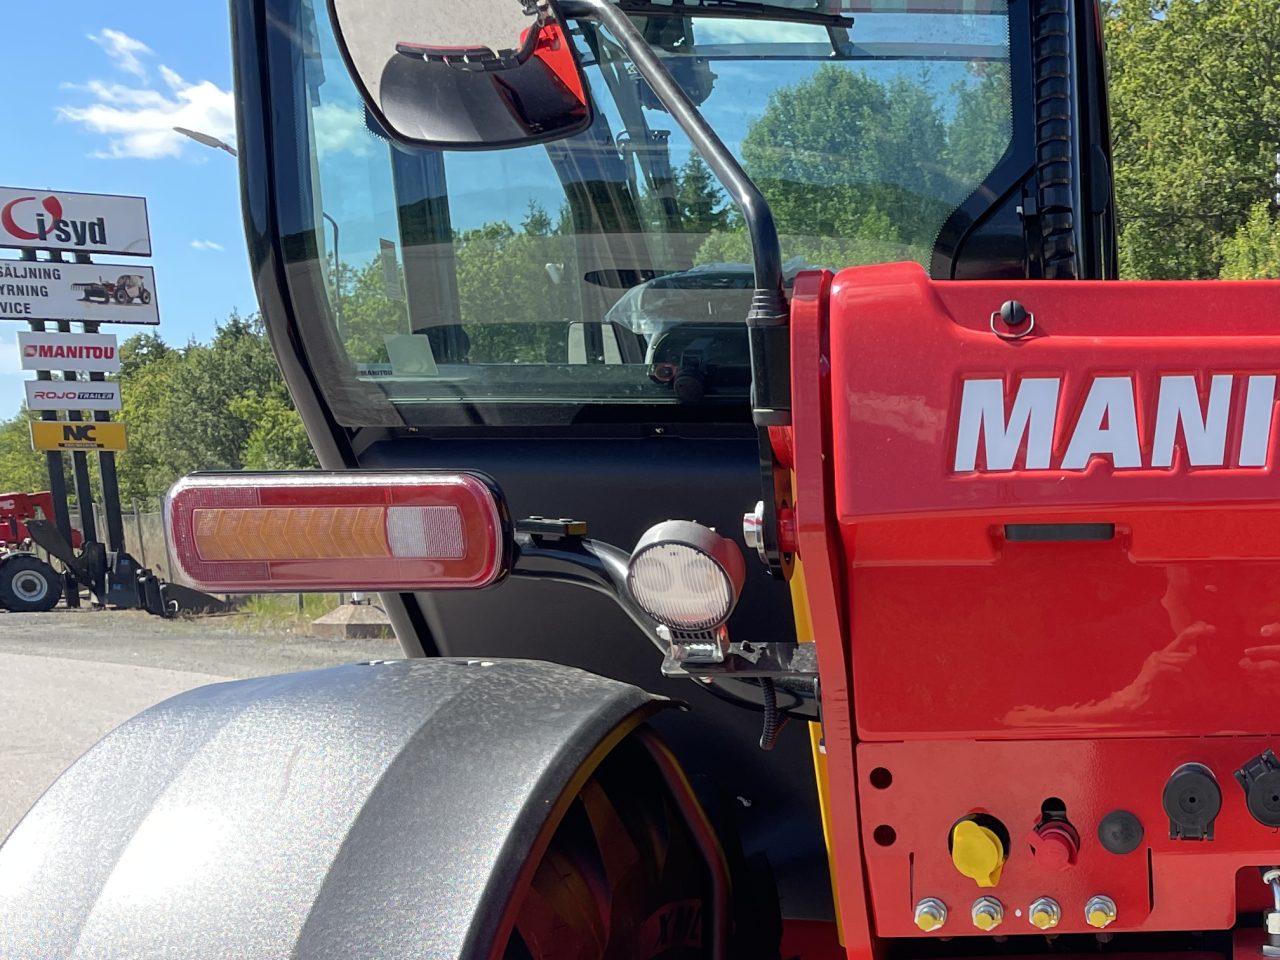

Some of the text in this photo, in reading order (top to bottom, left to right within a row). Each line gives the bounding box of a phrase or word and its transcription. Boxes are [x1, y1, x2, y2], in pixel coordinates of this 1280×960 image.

[39, 345, 114, 359] MANITOU
[34, 391, 113, 400] ROJO TRAILER
[63, 425, 96, 441] NC
